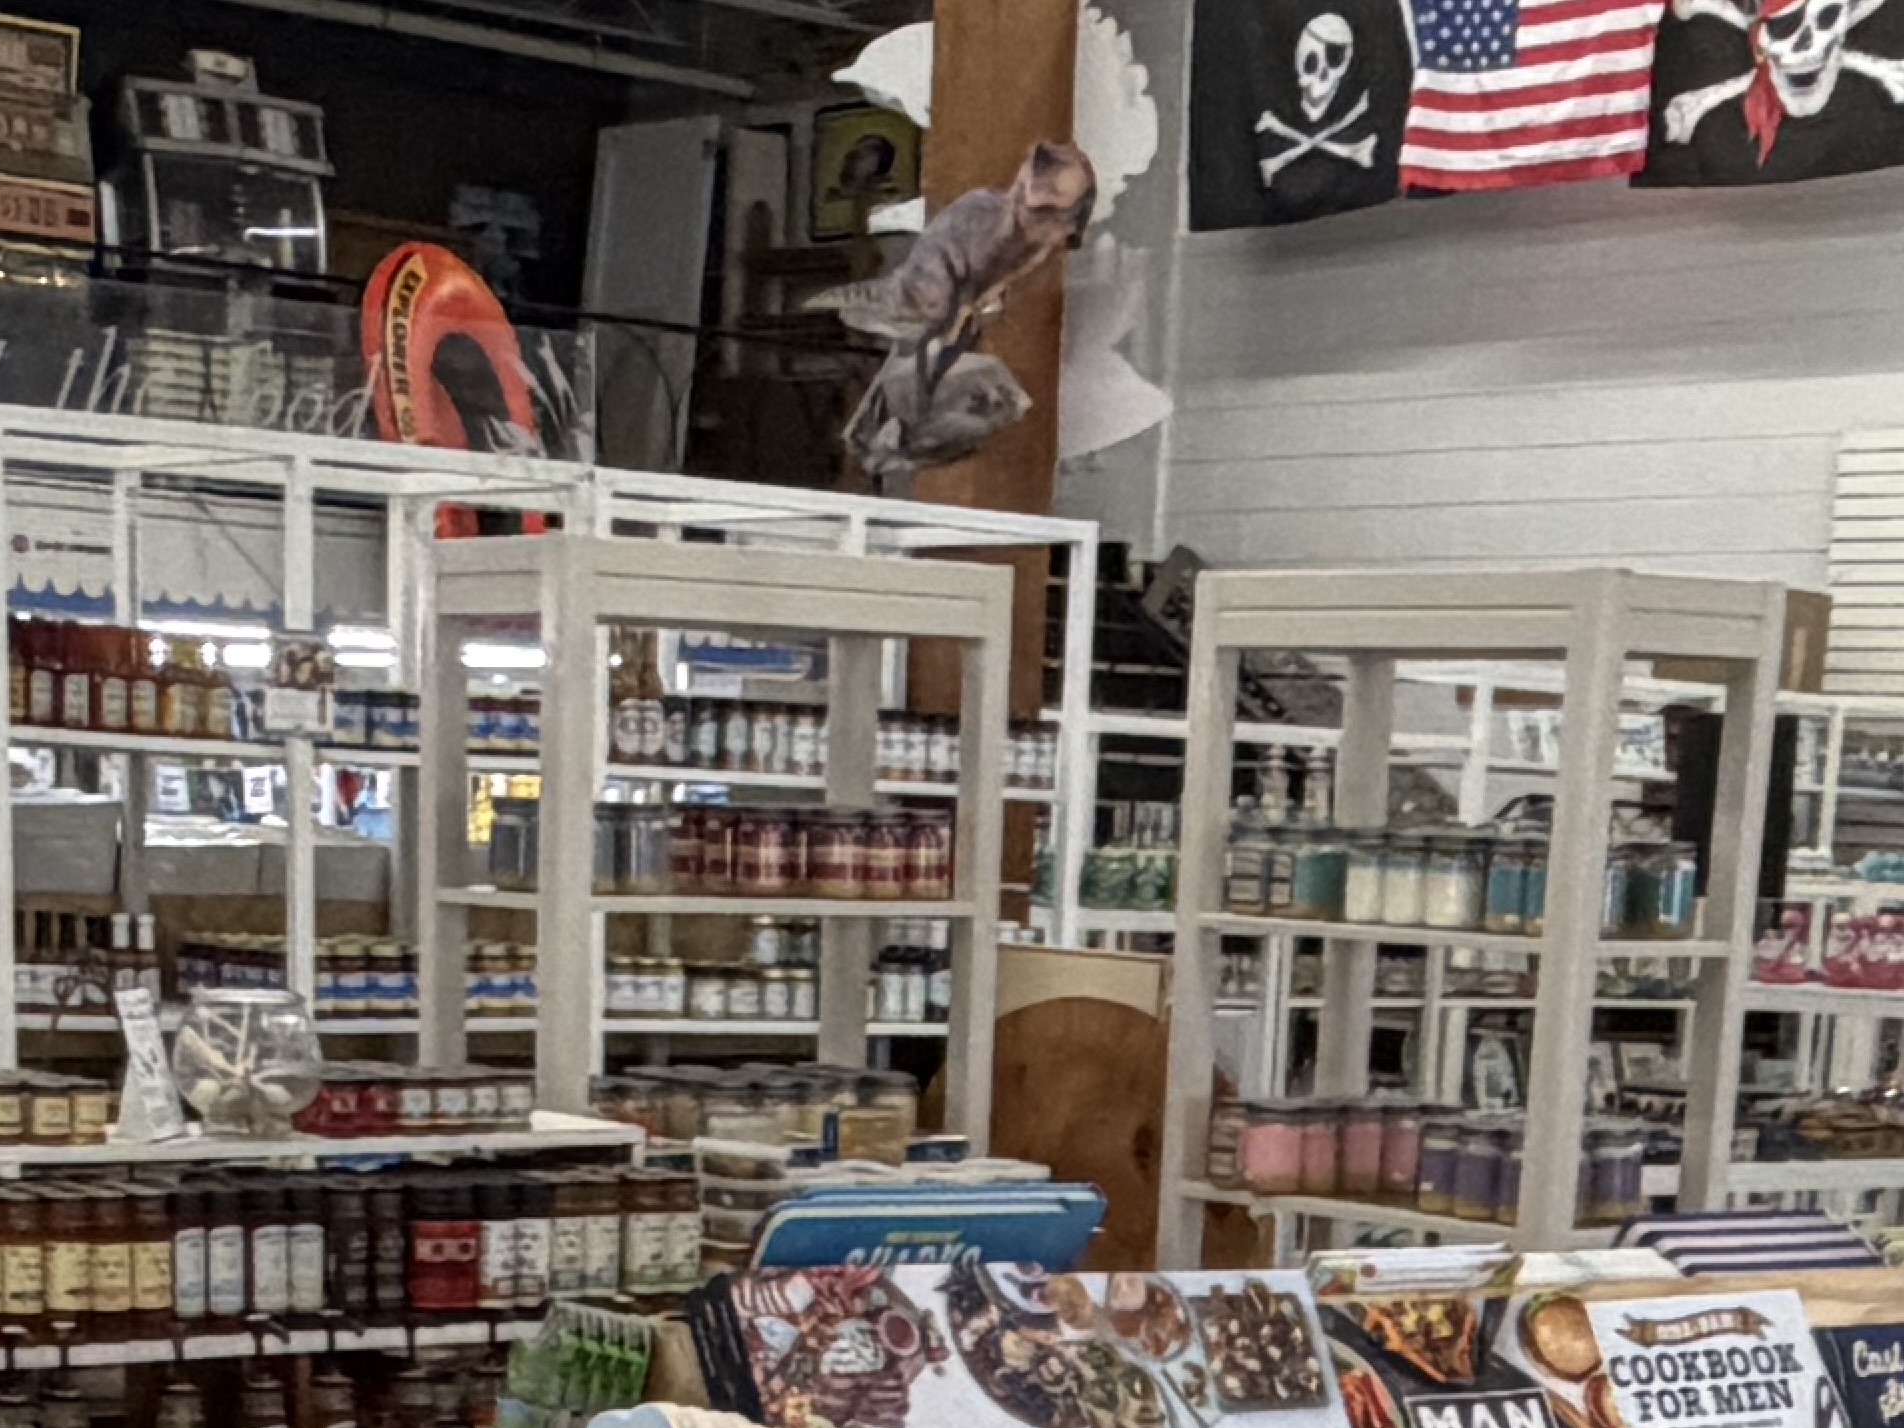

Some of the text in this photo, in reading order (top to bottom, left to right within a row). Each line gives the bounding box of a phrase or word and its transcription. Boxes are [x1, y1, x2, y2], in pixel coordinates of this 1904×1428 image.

[1608, 1343, 1805, 1388] COOKBOOK
[1632, 1378, 1794, 1423] FOR MEN
